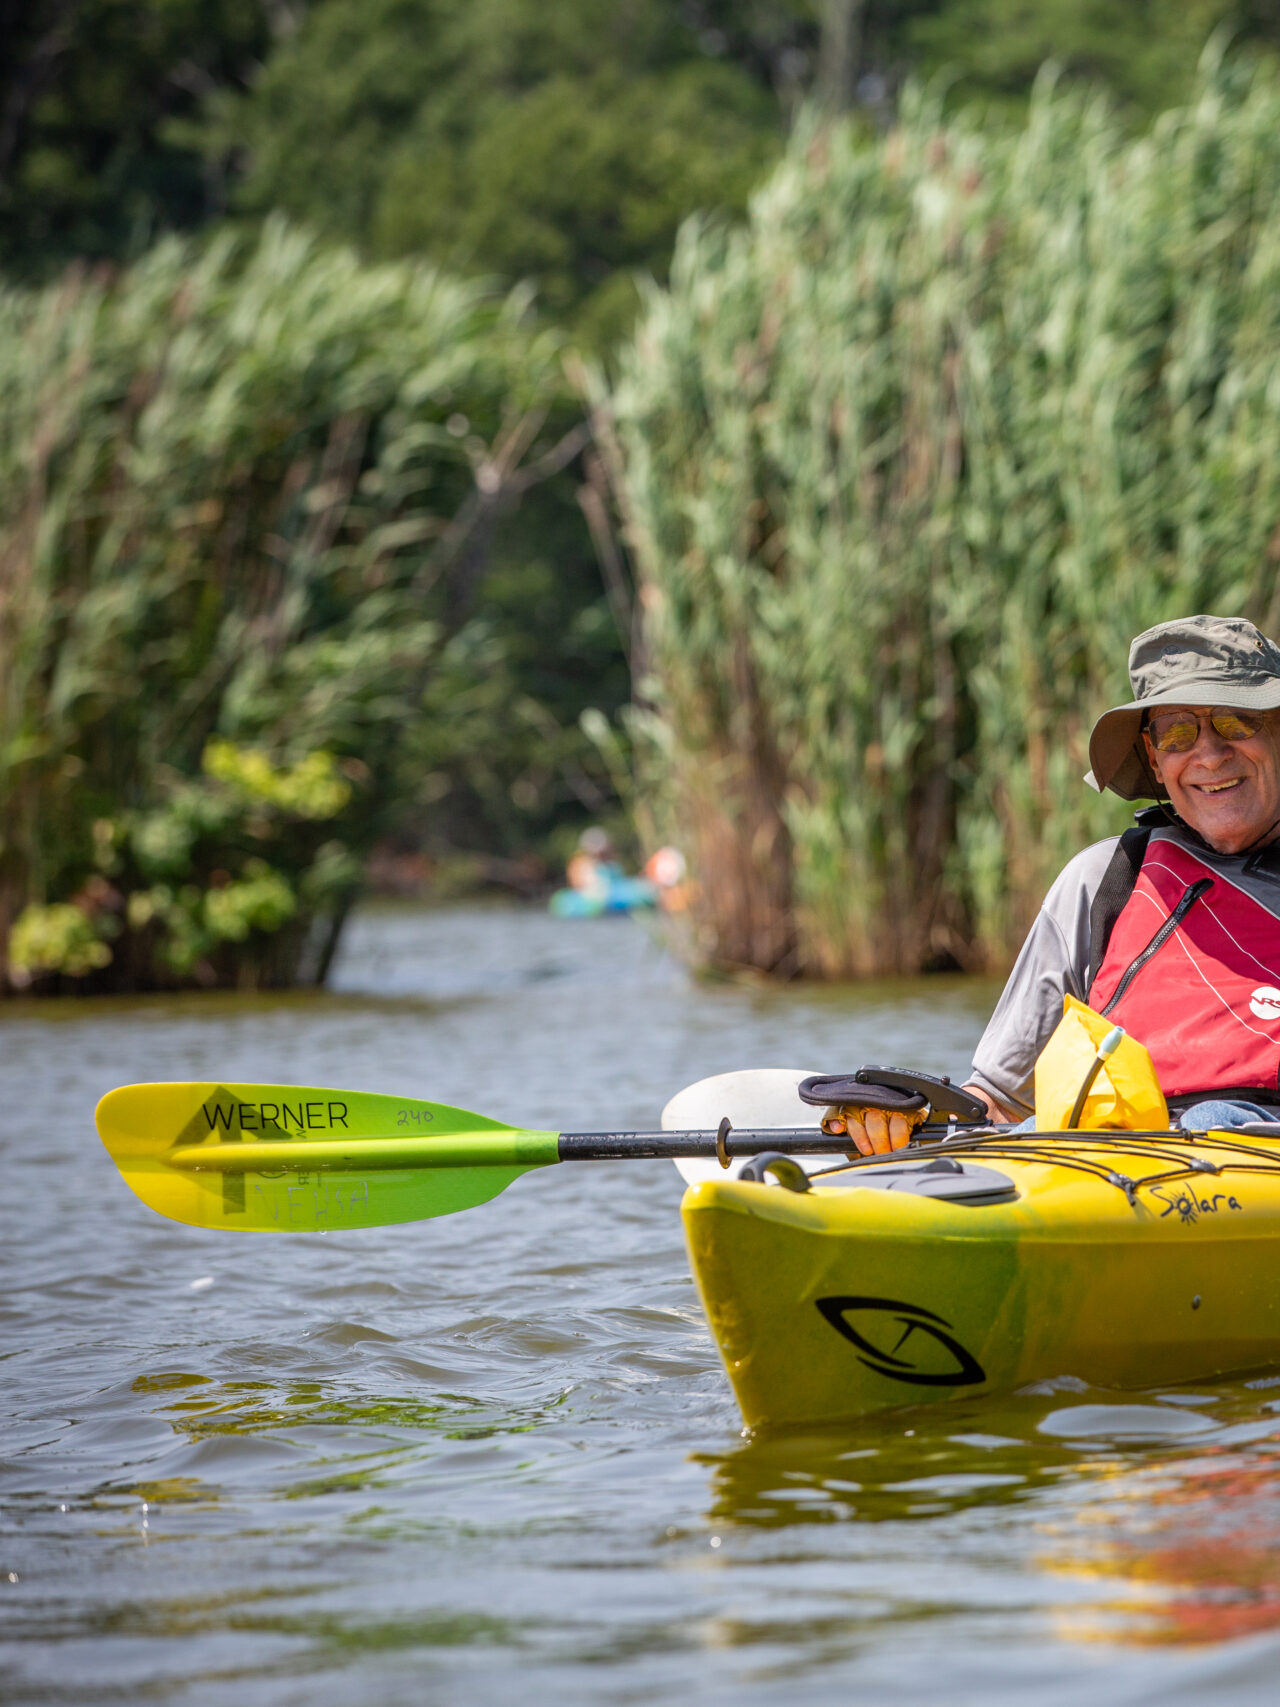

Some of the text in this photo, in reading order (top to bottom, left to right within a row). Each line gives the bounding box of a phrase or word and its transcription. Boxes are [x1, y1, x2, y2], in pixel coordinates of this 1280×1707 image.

[202, 1102, 349, 1130] WERNER
[397, 1110, 434, 1126] 240
[1150, 1182, 1242, 1222] Solara
